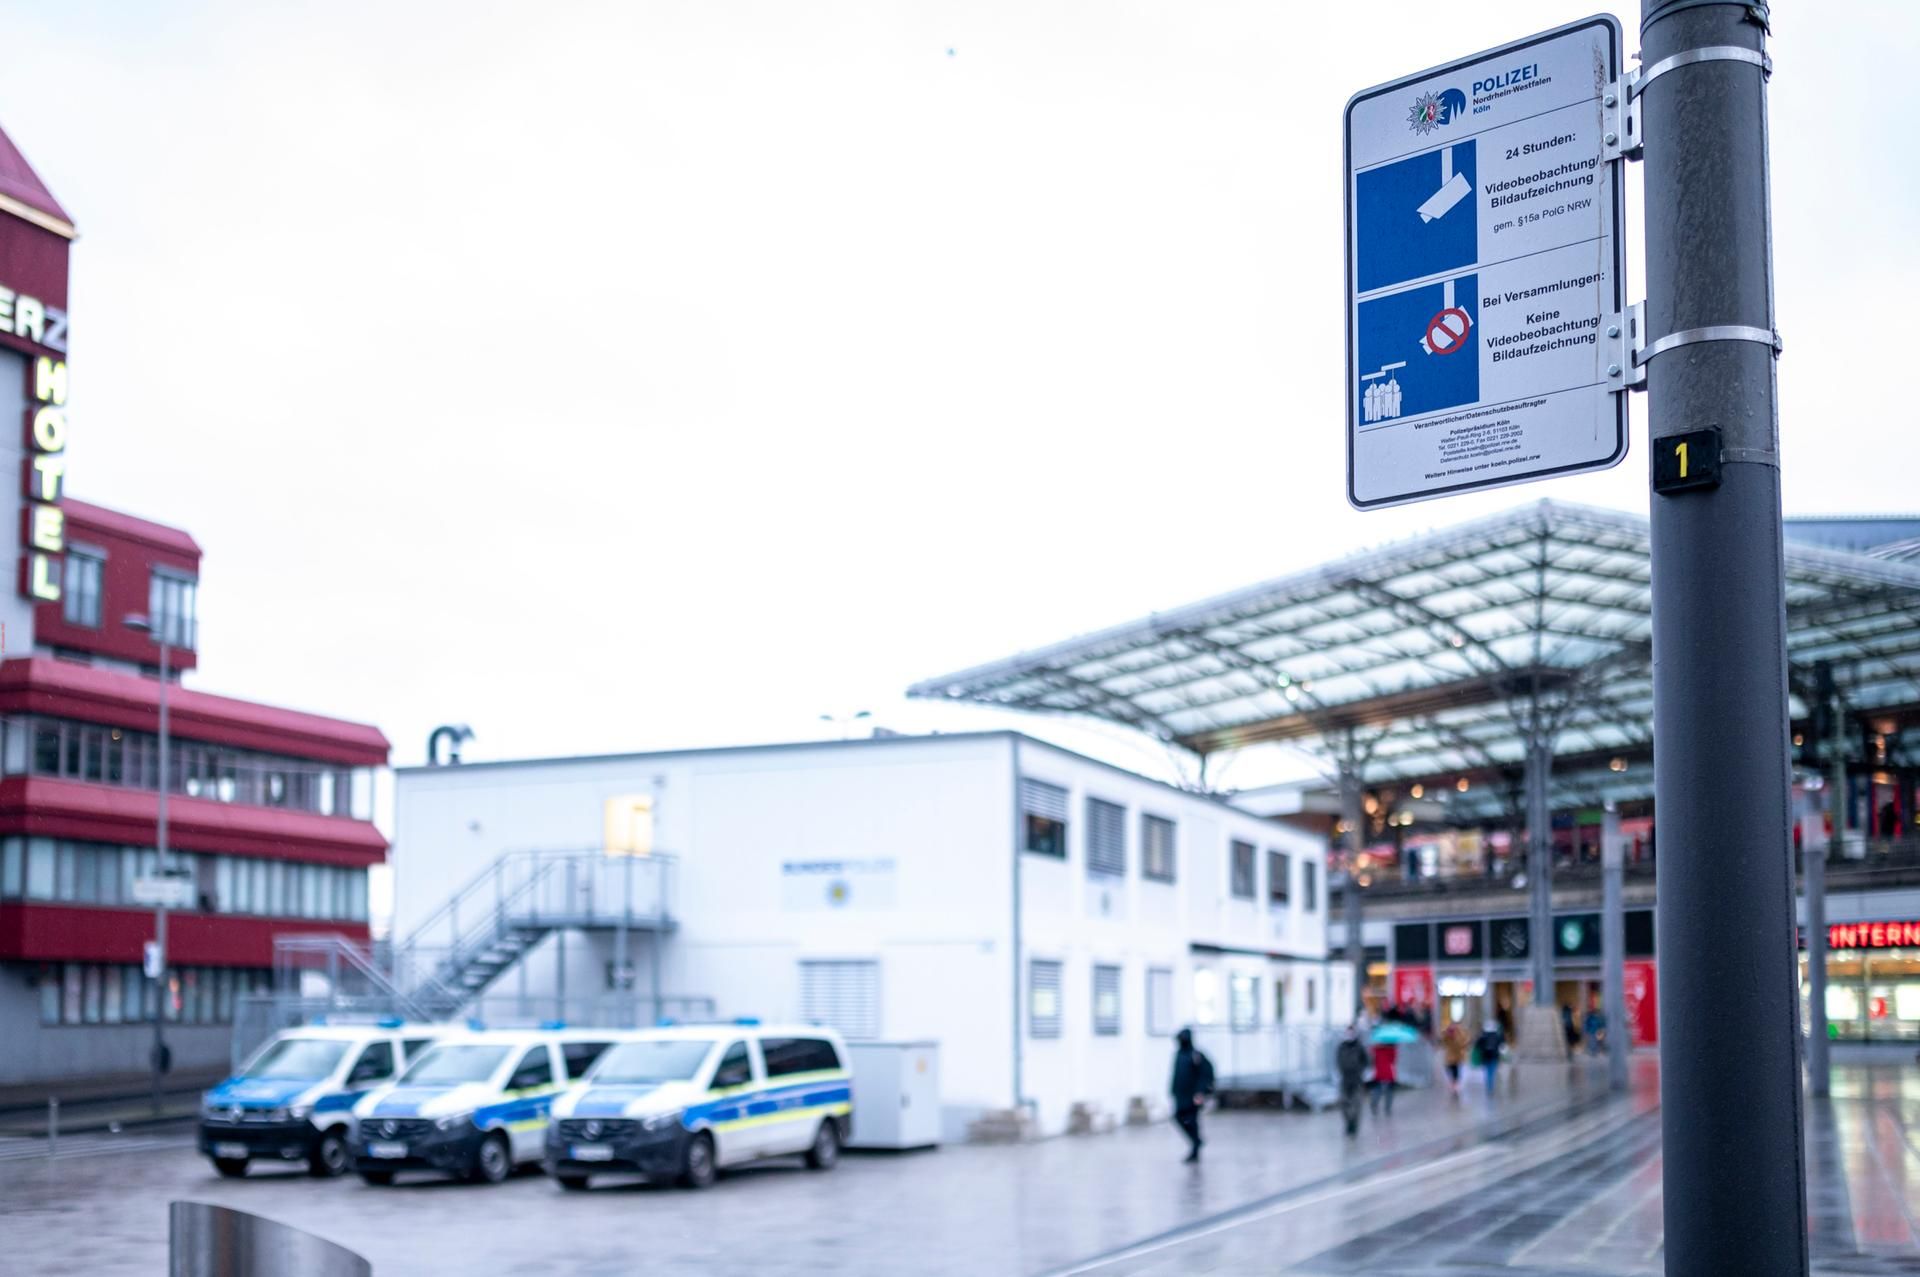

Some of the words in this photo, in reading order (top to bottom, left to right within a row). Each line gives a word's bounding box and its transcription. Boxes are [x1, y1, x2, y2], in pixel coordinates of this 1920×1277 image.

[1473, 63, 1538, 96] POLIZEI
[1473, 77, 1552, 105] Nordrhein-Westfalen
[1473, 104, 1491, 115] Köln
[1505, 148, 1520, 160] 24
[1522, 133, 1577, 155] Stunden:
[1485, 154, 1600, 195] Videobeobachtung/
[1491, 174, 1594, 209] Bildaufzeichnung
[1493, 221, 1515, 234] gem.
[1517, 212, 1540, 227] §15a
[1542, 205, 1565, 219] PolG
[1567, 198, 1592, 213] NRW
[1483, 294, 1501, 308] Bei
[1504, 272, 1605, 303] Versammlungen:
[1486, 313, 1602, 349] Videobeobachtung/
[1526, 309, 1560, 325] Keine
[1493, 332, 1596, 363] Bildaufzeichnung
[1447, 466, 1473, 476] Hinweise
[1474, 463, 1490, 471] unter
[1675, 442, 1688, 478] 1
[33, 355, 68, 601] HOTEL
